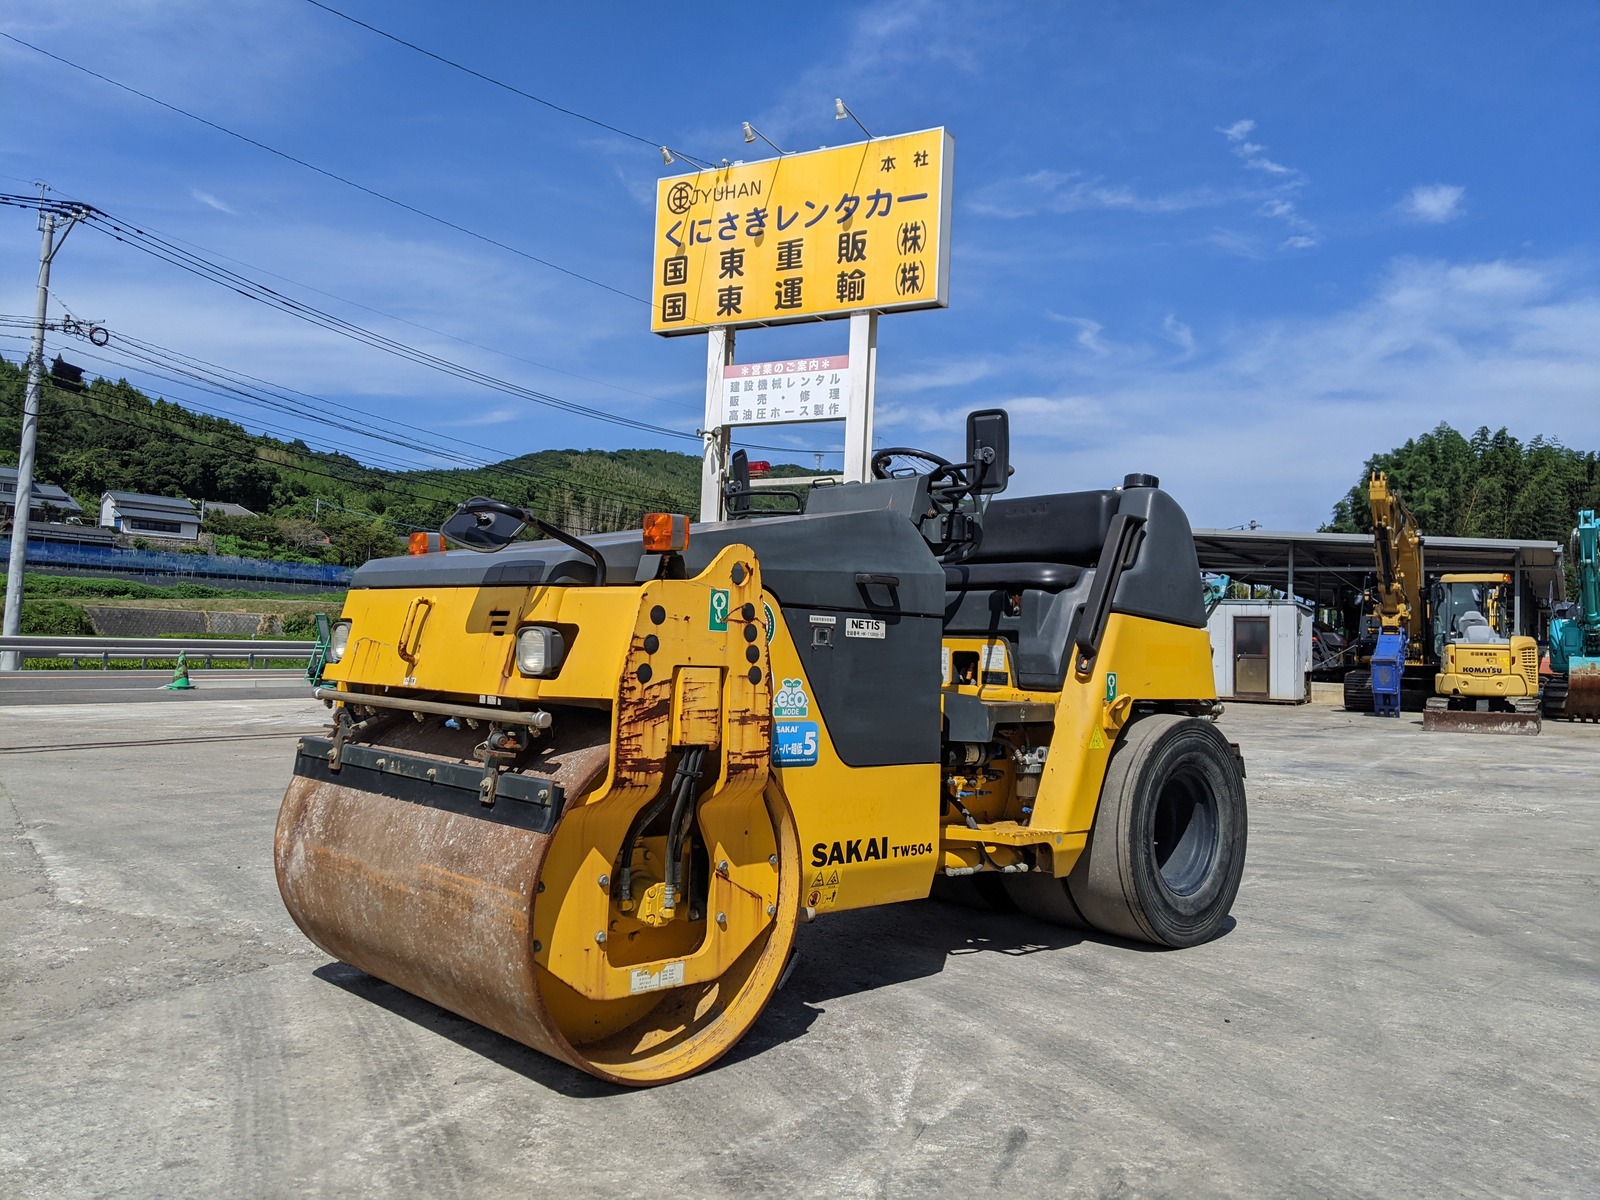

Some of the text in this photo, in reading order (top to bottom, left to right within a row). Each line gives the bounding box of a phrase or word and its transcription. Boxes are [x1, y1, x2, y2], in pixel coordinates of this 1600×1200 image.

[880, 150, 928, 173] 本社
[689, 180, 761, 206] JYUHAN
[665, 188, 928, 247] くにさきレンタカー
[730, 373, 841, 393] 建設機械レンタル
[729, 403, 840, 422] 高油圧ホース製作
[851, 619, 880, 632] NETIS
[1463, 666, 1502, 674] KOMATSU
[777, 691, 806, 708] eco
[781, 708, 800, 716] MODE
[776, 725, 798, 734] SAKAI
[803, 731, 817, 756] 5
[811, 836, 933, 868] SAKAI TW504
